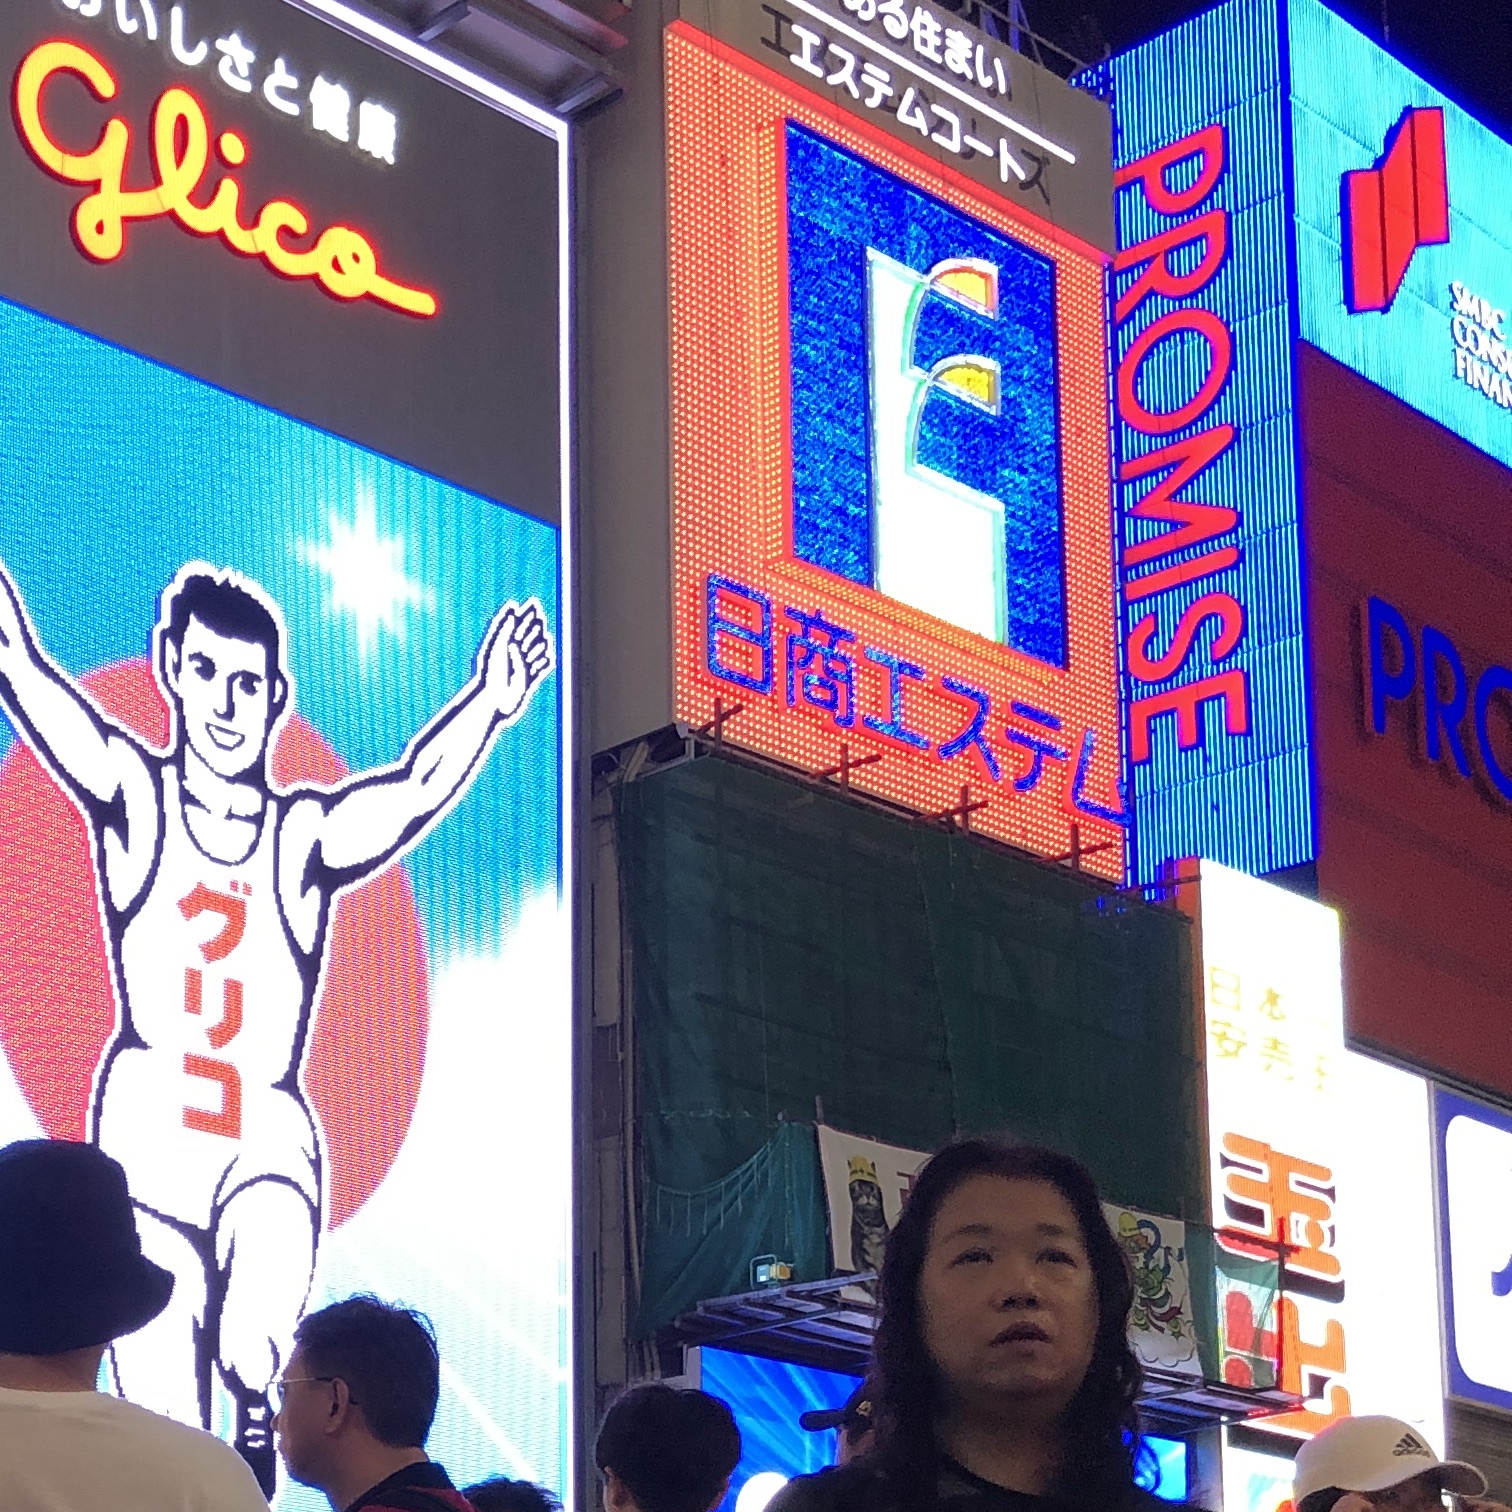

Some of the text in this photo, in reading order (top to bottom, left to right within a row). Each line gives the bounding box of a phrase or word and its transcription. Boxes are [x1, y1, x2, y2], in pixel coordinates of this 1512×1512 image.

[13, 40, 437, 316] Glico
[1115, 124, 1251, 763] PROMISE
[705, 573, 1131, 824] 日商エステム
[176, 879, 253, 1140] グリコ
